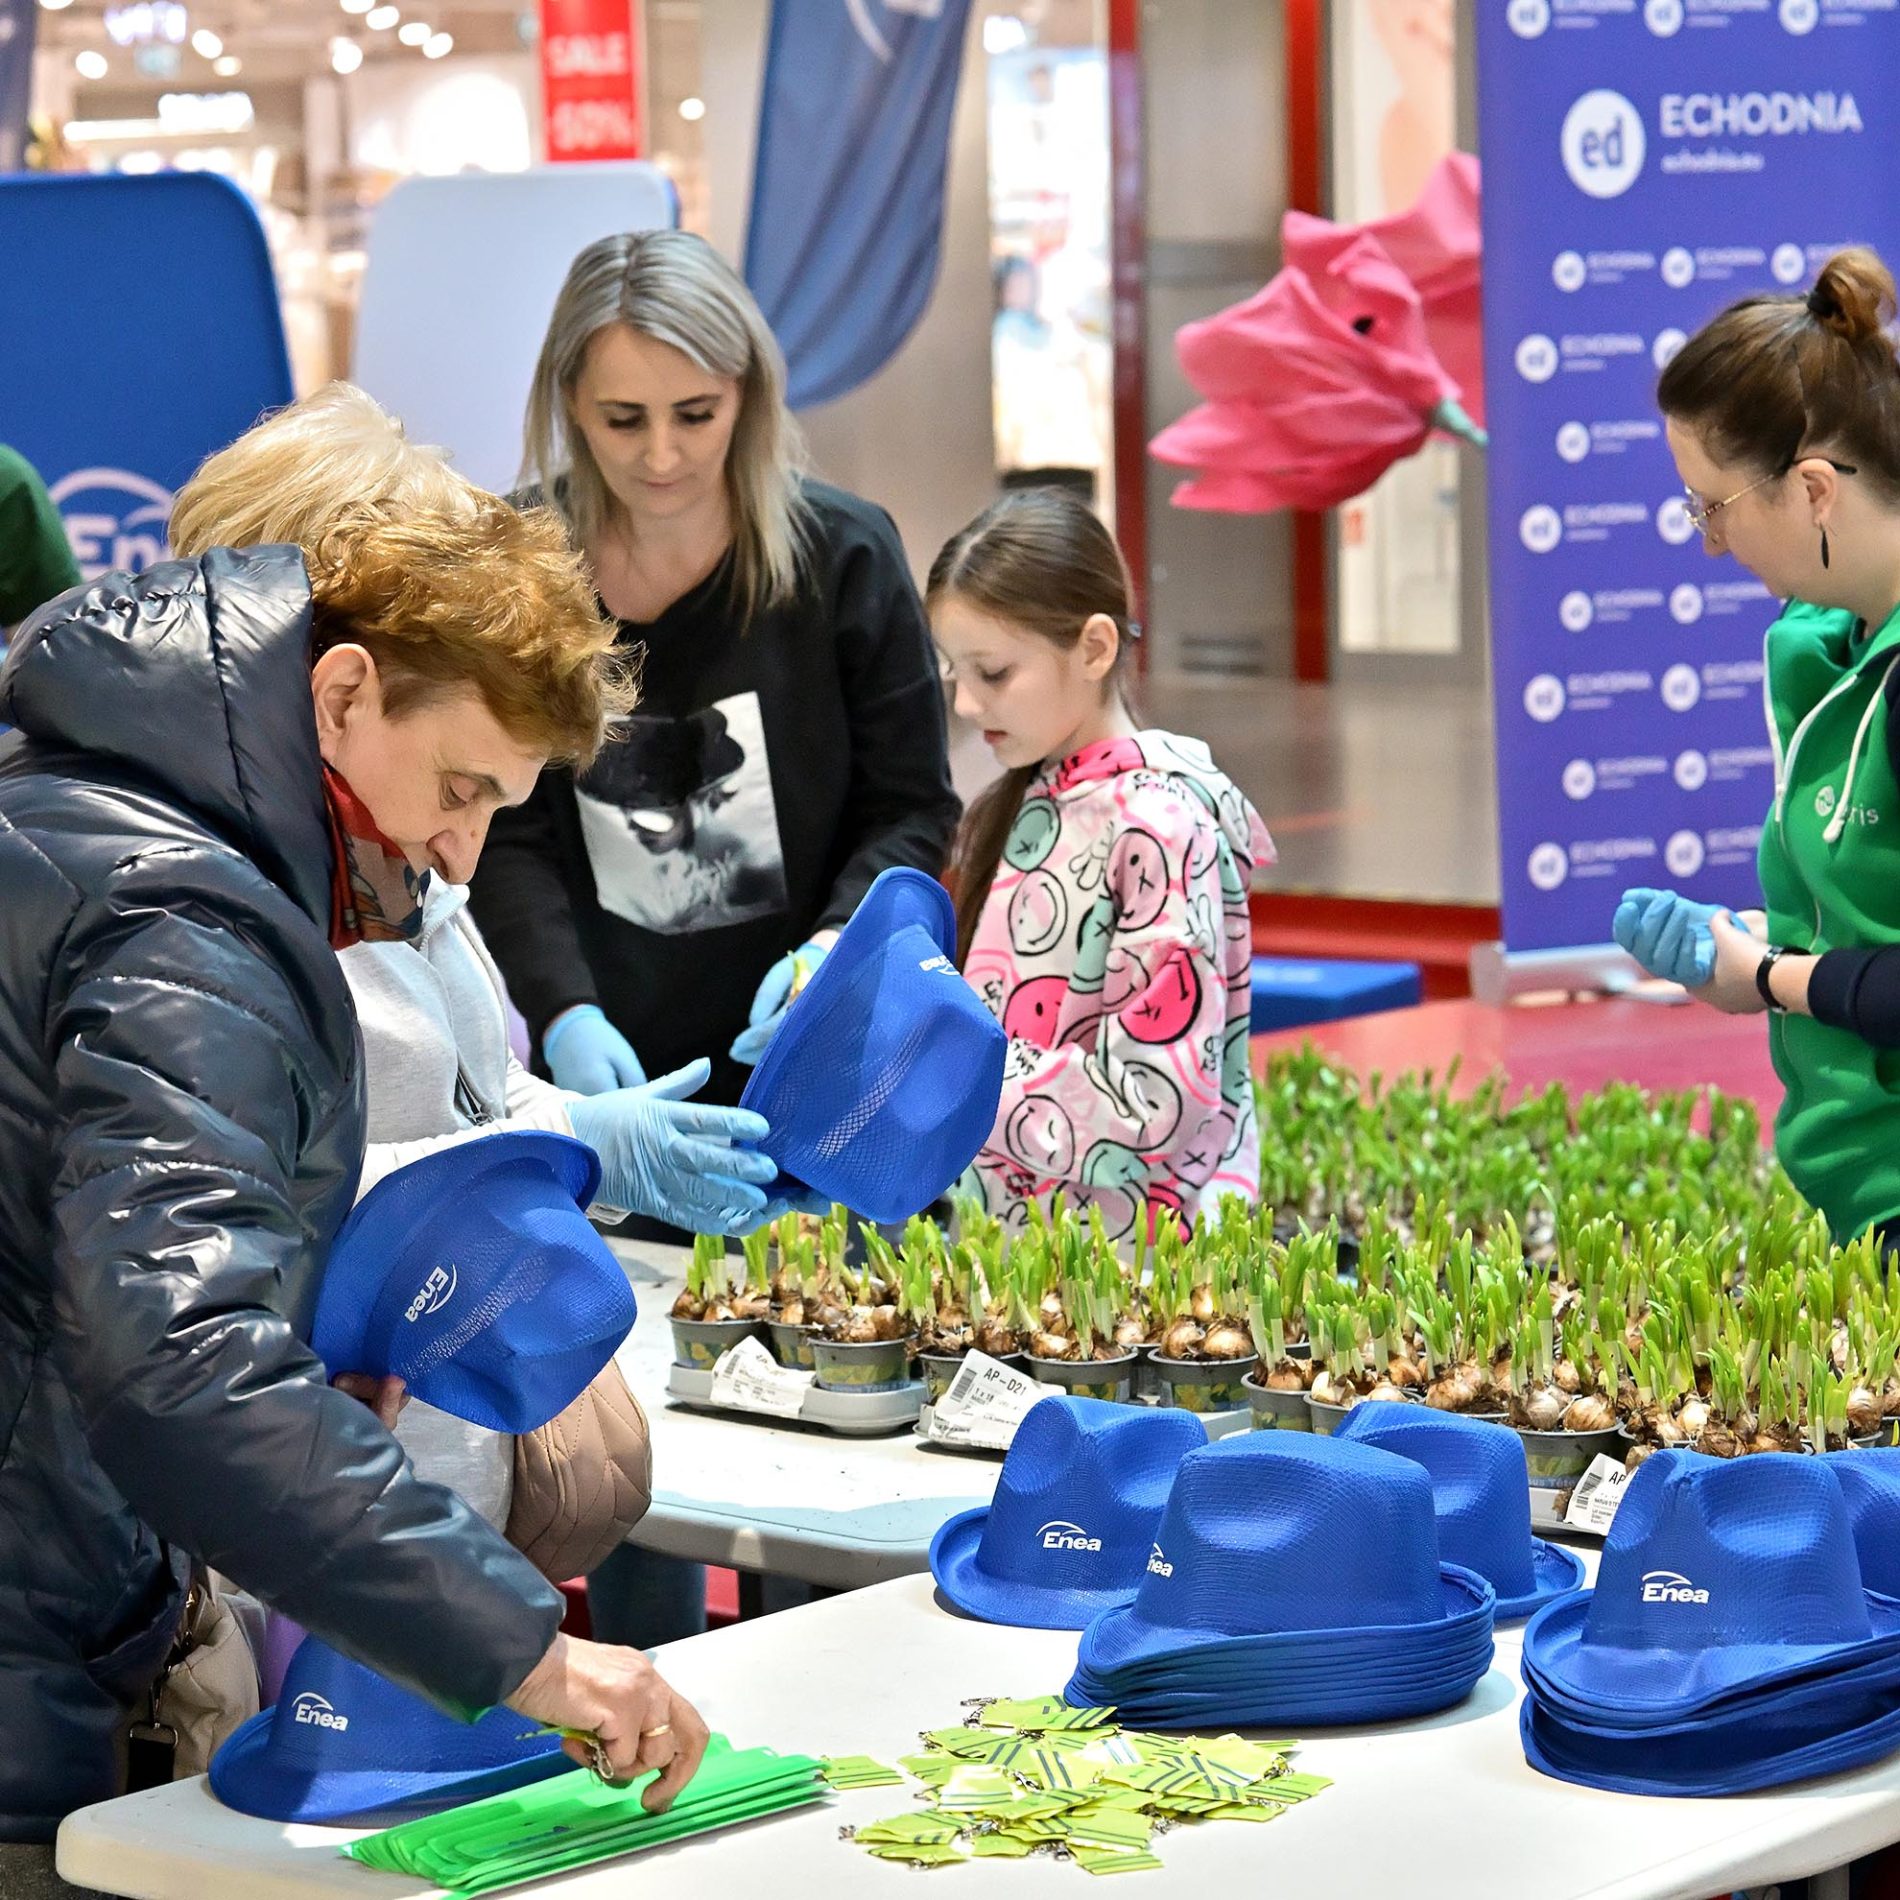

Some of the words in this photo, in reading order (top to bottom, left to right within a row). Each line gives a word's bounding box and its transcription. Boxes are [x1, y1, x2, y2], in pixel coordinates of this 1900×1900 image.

[1659, 91, 1863, 137] ECHODNIA
[1581, 116, 1625, 168] ed
[404, 1266, 449, 1322] Enea
[1042, 1531, 1102, 1551] Enea
[1146, 1558, 1174, 1578] nea
[1642, 1583, 1710, 1604] Enea
[295, 1703, 349, 1731] Enea
